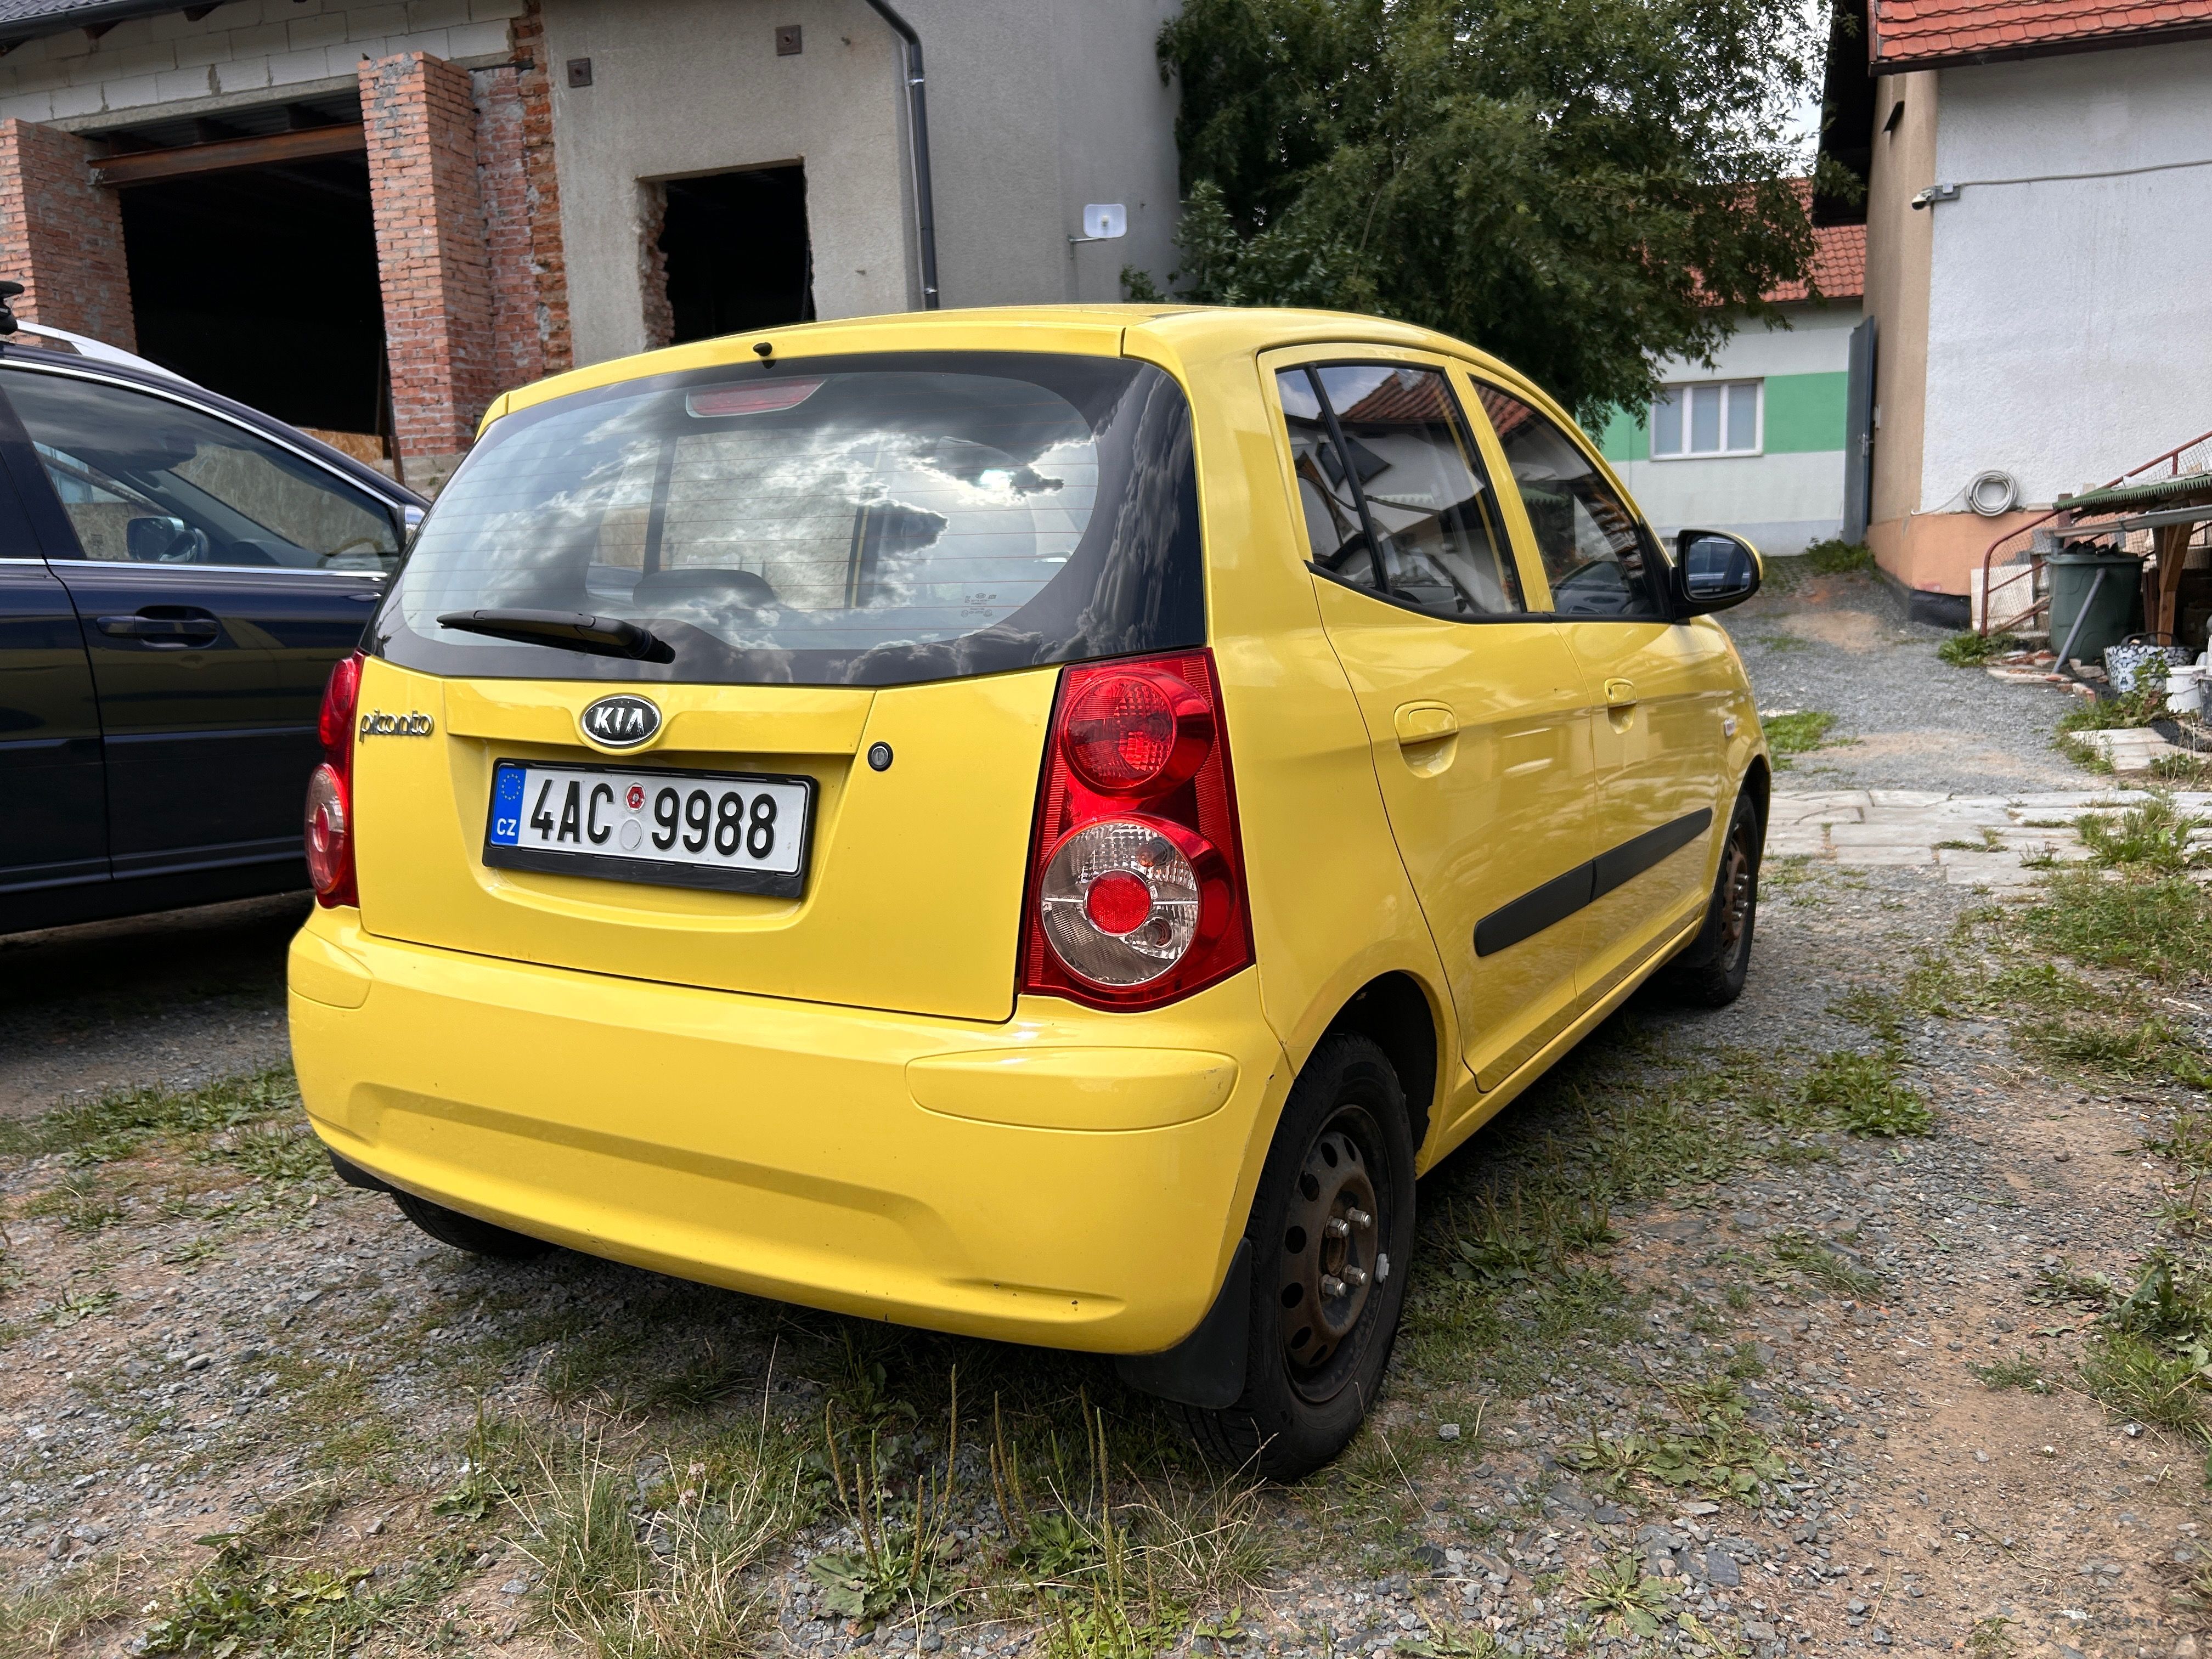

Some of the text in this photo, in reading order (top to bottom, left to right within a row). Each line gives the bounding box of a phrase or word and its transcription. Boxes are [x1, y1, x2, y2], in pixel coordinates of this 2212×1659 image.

[359, 708, 435, 744] picanto
[594, 707, 645, 735] KIA
[496, 817, 517, 837] CZ
[530, 779, 778, 859] 4AC 9988
